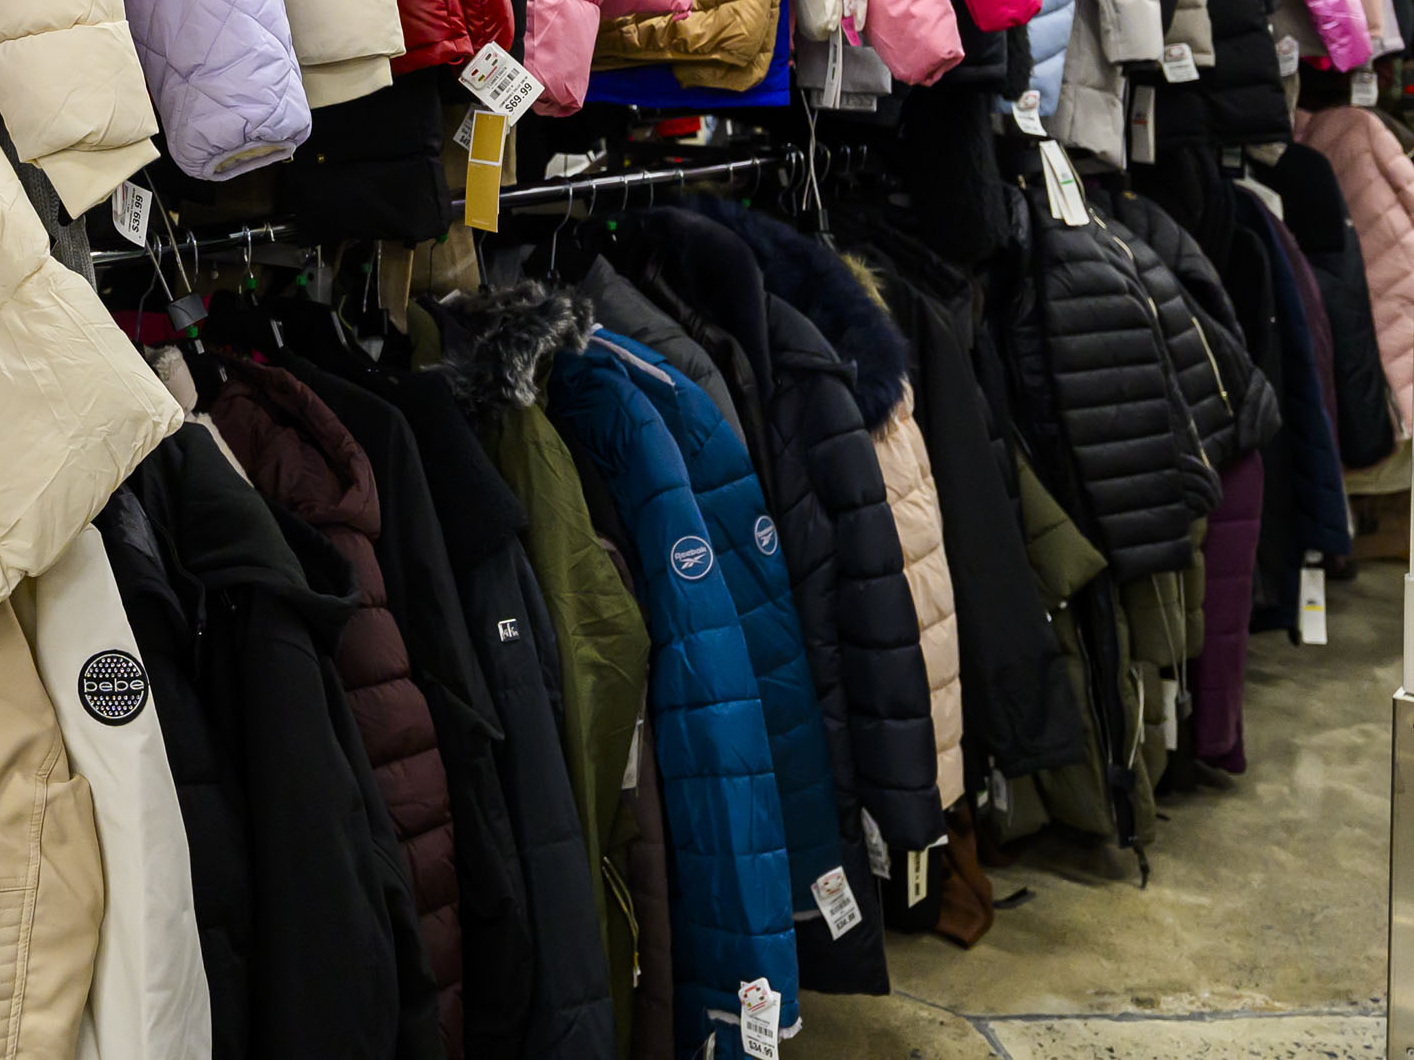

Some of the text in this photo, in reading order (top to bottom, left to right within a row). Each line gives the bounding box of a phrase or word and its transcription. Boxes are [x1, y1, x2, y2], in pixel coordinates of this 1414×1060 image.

[504, 82, 534, 113] $69.99
[131, 194, 144, 233] $39.99
[674, 546, 707, 561] Reebok
[83, 677, 145, 693] bebe
